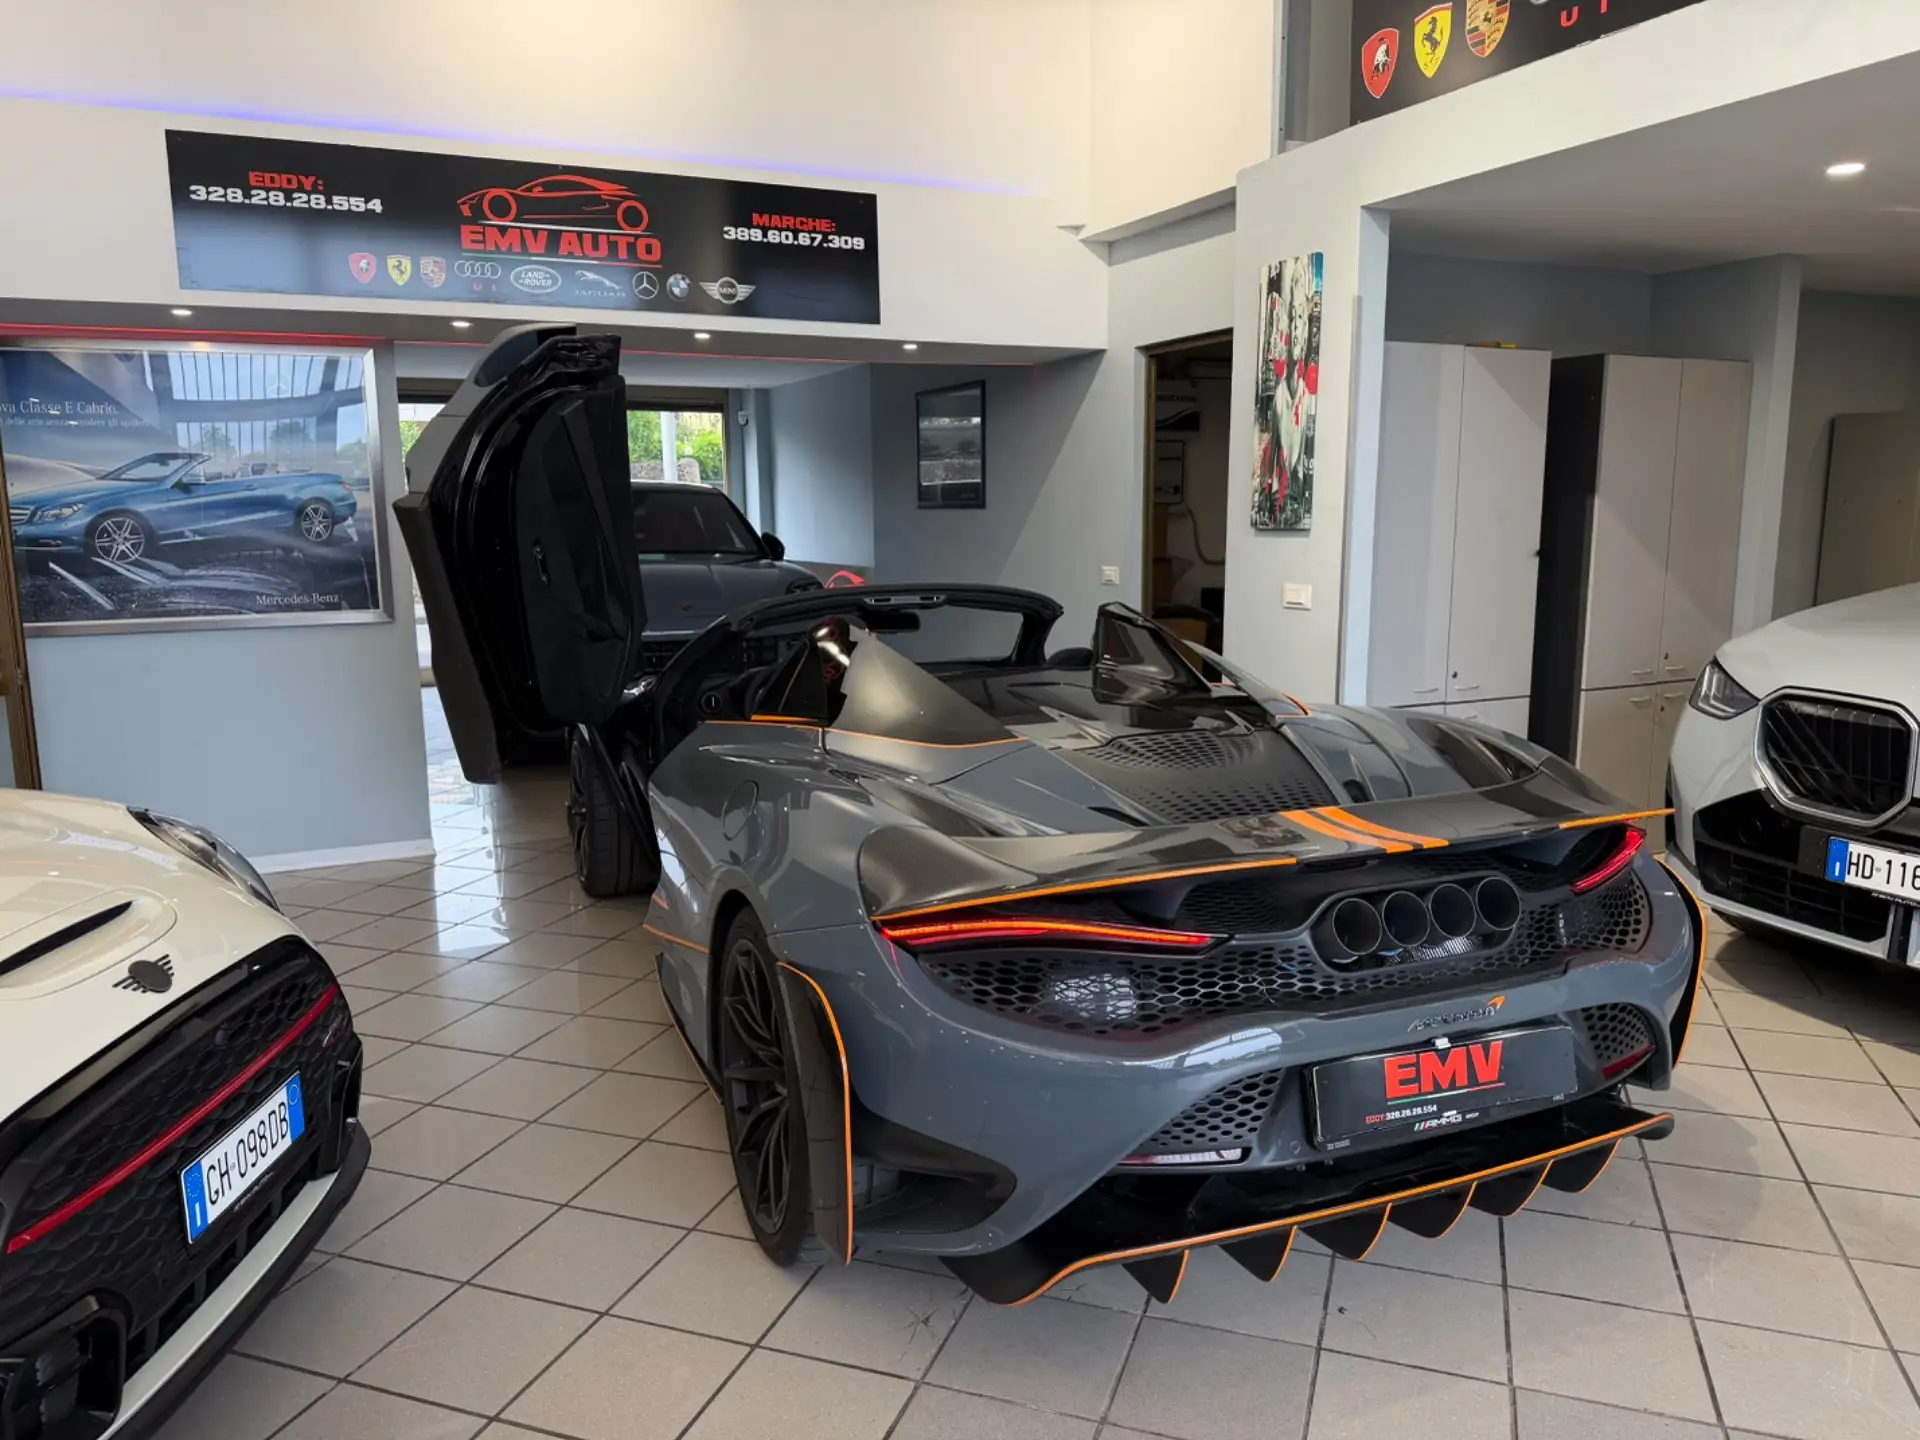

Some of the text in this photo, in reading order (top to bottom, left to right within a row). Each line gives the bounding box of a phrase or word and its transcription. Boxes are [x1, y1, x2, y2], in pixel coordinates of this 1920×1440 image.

[248, 171, 324, 191] EDDY:
[189, 185, 383, 213] 328.28.28.554
[752, 212, 836, 232] MARCHE:
[460, 224, 662, 262] EMV AUTO
[723, 226, 865, 250] 389.60.67.309
[521, 271, 546, 279] LAND
[523, 279, 552, 287] ROVER
[20, 401, 60, 413] Classe
[1384, 1040, 1503, 1099] EMV
